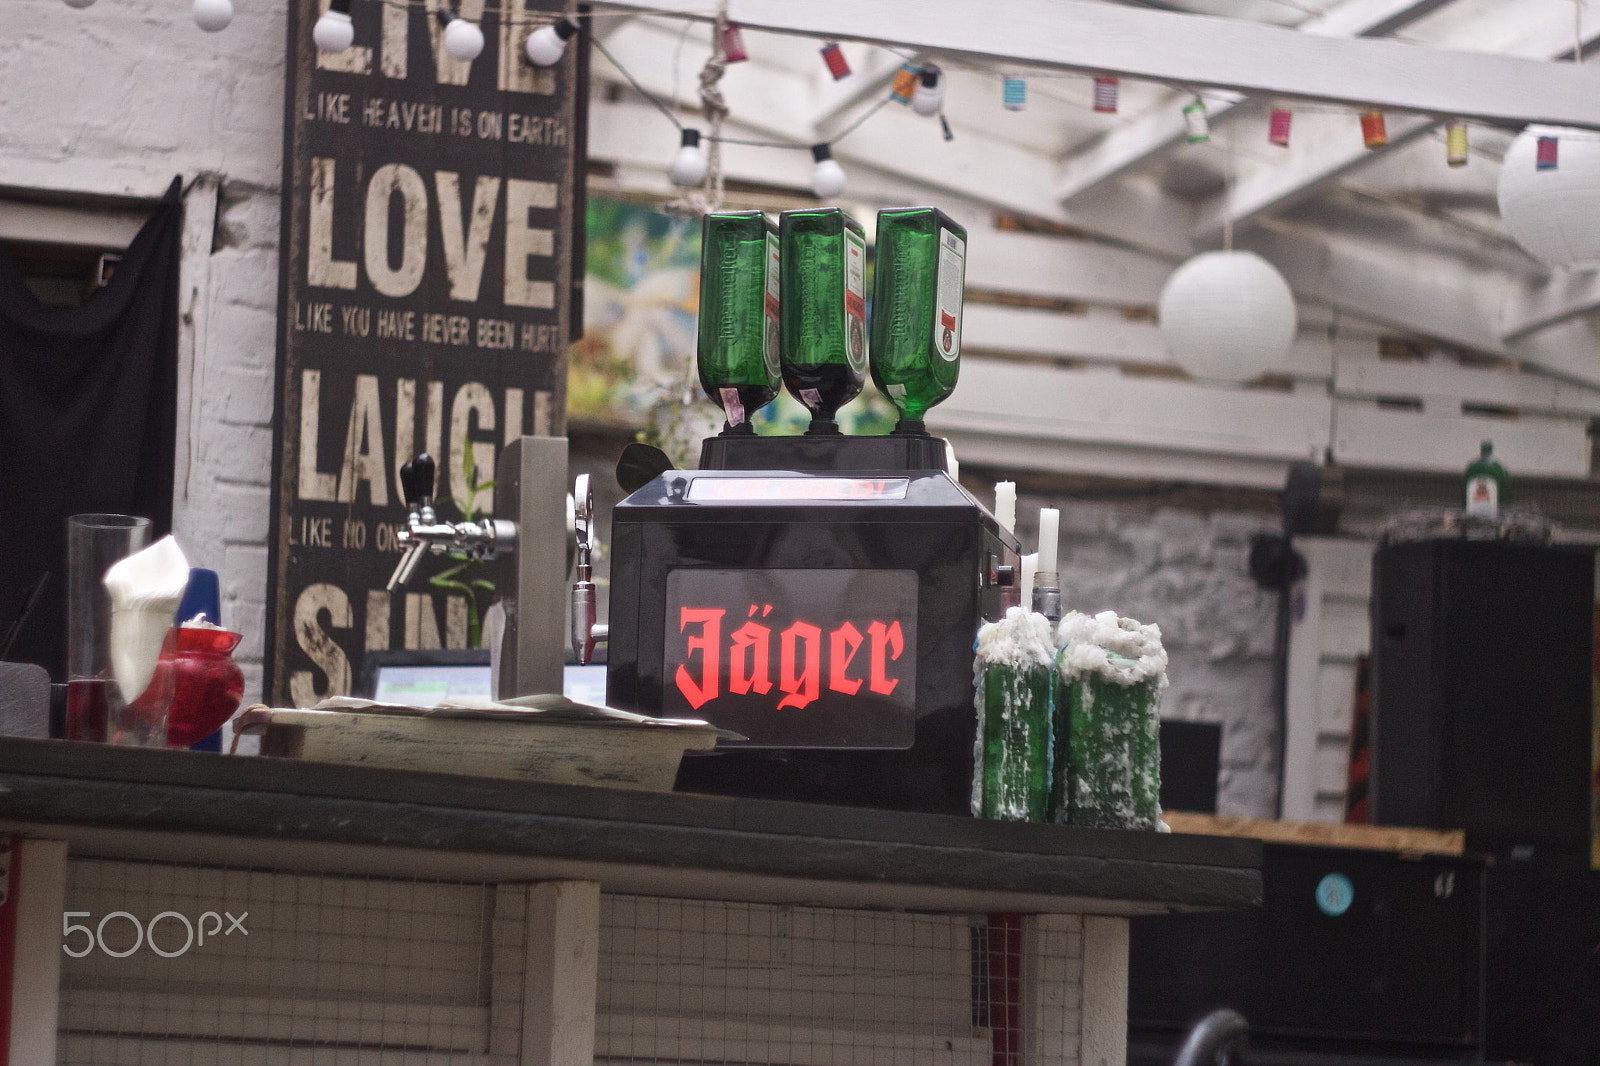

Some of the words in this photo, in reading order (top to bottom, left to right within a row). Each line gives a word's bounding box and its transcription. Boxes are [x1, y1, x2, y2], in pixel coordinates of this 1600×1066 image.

[303, 91, 350, 124] LIKE
[362, 97, 443, 135] HEAVEN
[450, 107, 473, 137] IS
[477, 111, 502, 141] ON
[507, 112, 568, 147] EARTH
[307, 156, 558, 310] LOVE
[294, 302, 333, 334] LIKE
[341, 306, 371, 338] YOU
[377, 309, 416, 341] HAVE
[422, 314, 470, 346] NEVER
[476, 319, 515, 350] BEEN
[520, 323, 559, 353] HURT
[712, 480, 768, 497] ICE
[778, 480, 886, 497] COLD!
[288, 516, 332, 548] LIKE
[343, 520, 367, 549] NO
[376, 522, 405, 552] ON
[290, 583, 502, 700] SIN
[675, 604, 904, 711] Jäger
